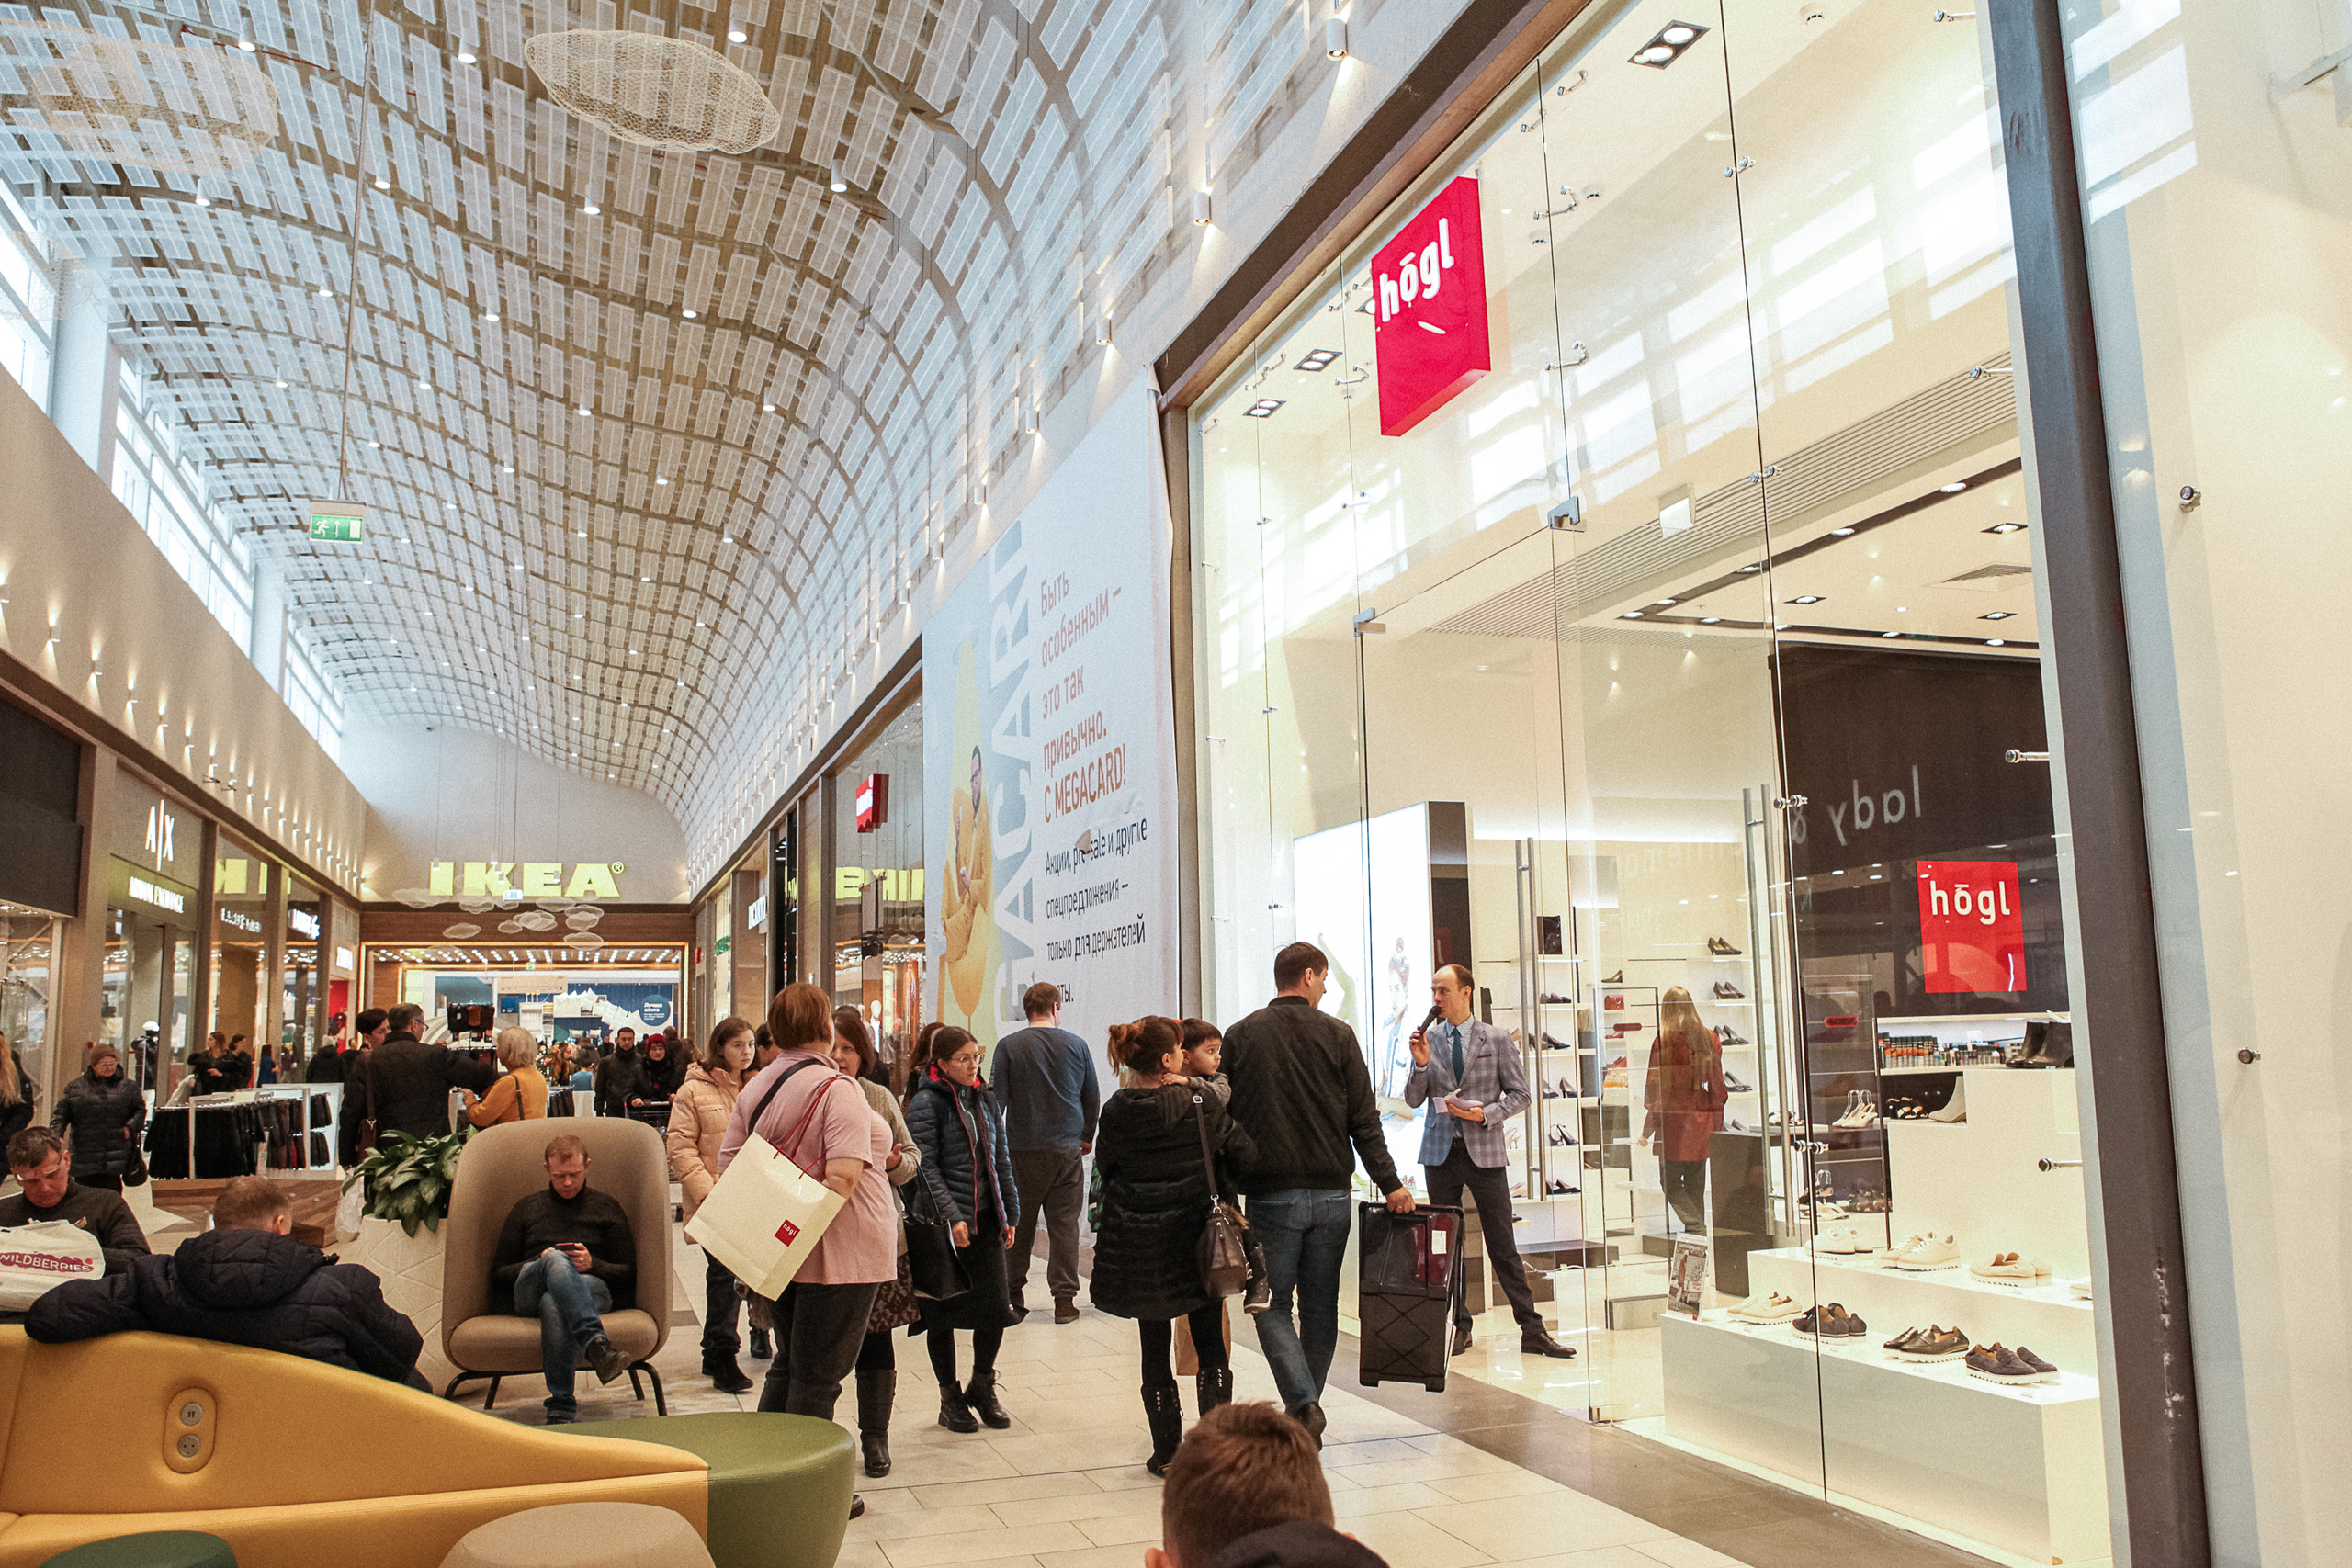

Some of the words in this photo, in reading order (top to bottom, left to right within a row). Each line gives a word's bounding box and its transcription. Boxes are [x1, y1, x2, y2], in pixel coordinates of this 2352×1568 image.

[1041, 571, 1069, 618] Быть
[1042, 588, 1109, 668] особенным
[1043, 683, 1060, 719] это
[1064, 665, 1084, 705] так
[1044, 710, 1107, 778] привычно.
[1055, 743, 1126, 819] MEGACARD!
[1046, 851, 1072, 877] Акции,
[1046, 878, 1120, 920] спецпредложения
[1047, 938, 1072, 961] только
[1075, 934, 1091, 962] для
[1092, 912, 1146, 959] держателей
[0, 1254, 92, 1272] WILDBERRIES
